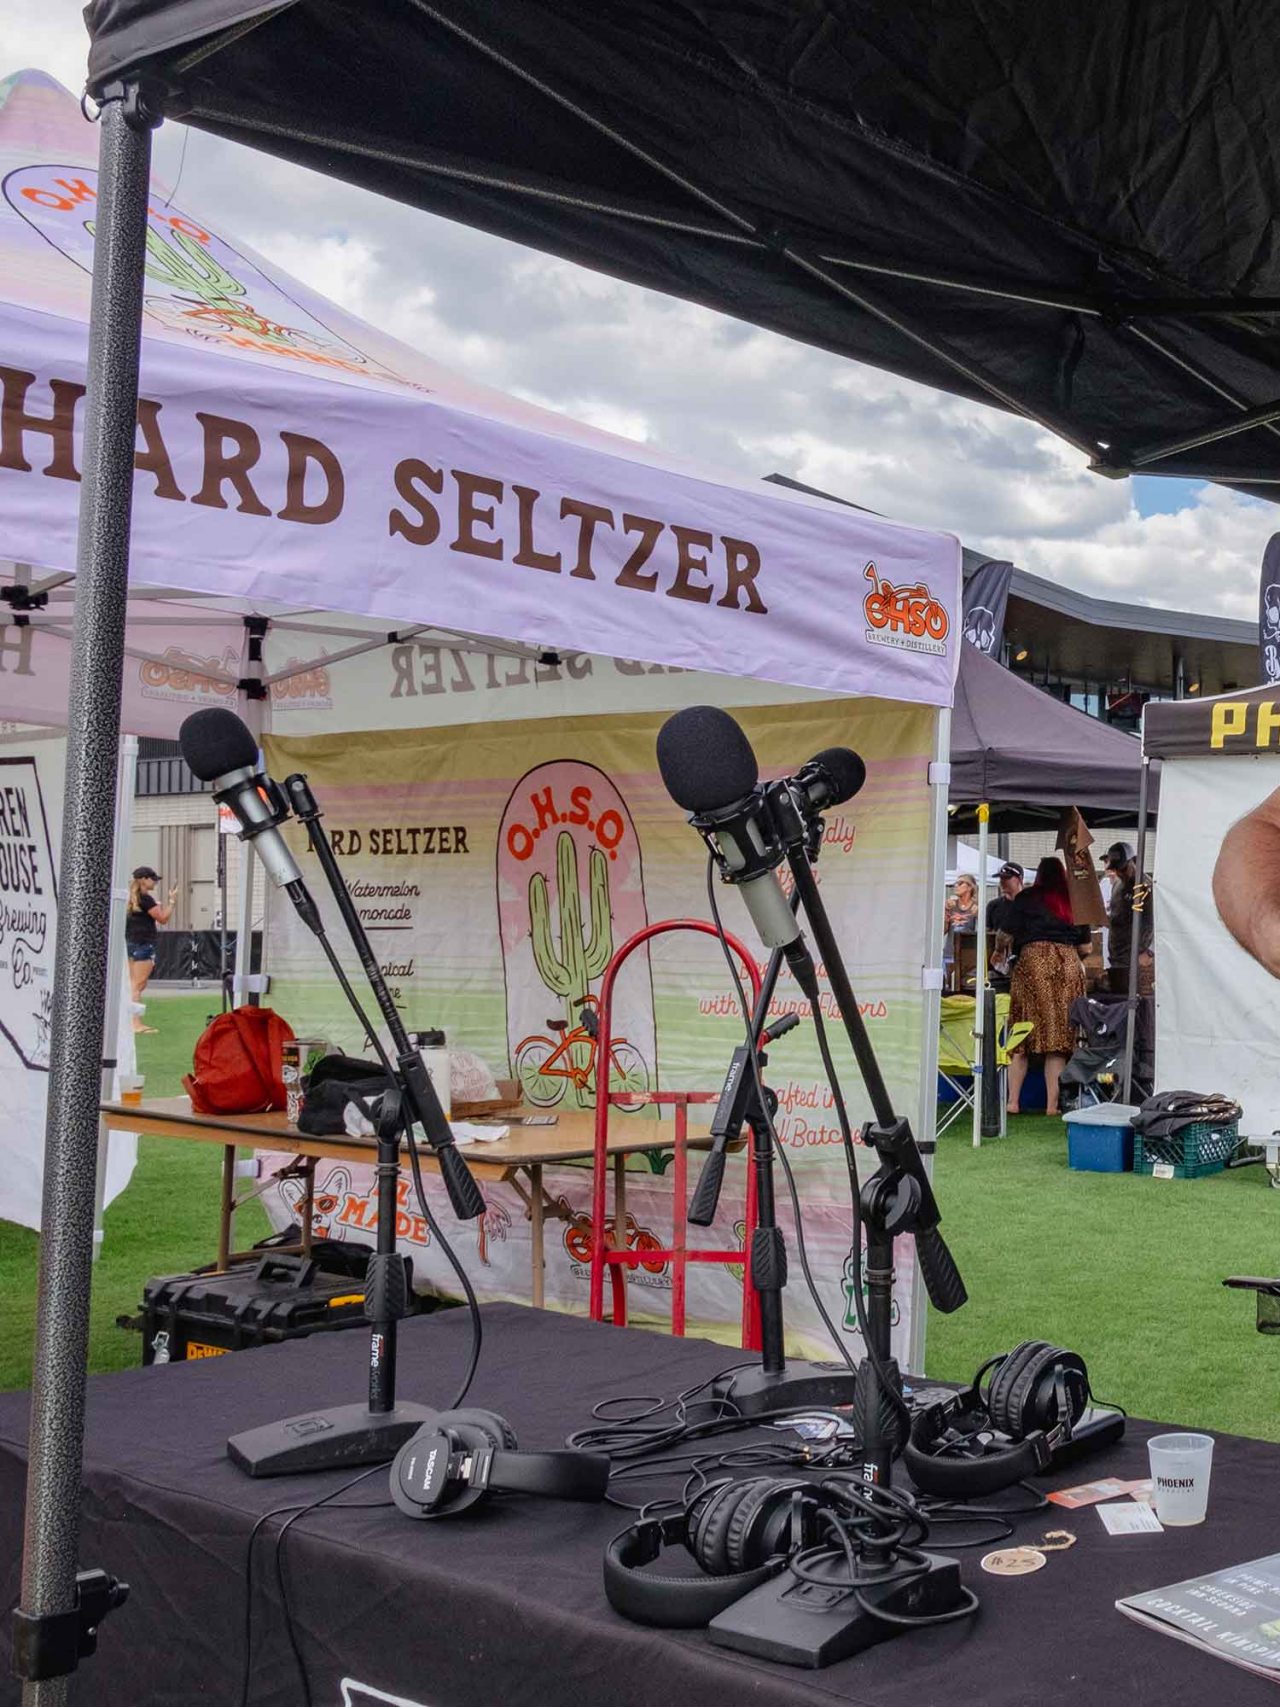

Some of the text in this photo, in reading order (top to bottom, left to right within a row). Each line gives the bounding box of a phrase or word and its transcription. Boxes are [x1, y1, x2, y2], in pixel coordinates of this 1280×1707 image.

[0, 365, 769, 616] HARD SELTZER
[866, 592, 948, 640] OHSO
[867, 632, 899, 645] BREWERY
[906, 640, 945, 655] DISTILLERY
[0, 787, 31, 838] REN
[369, 826, 470, 856] SELTZER
[0, 843, 43, 895] OUSE
[357, 903, 412, 921] monade
[700, 992, 735, 1016] with
[776, 1082, 819, 1114] afted
[423, 1448, 438, 1490] TASCAM
[1157, 1477, 1194, 1487] PHOENIX
[1147, 1598, 1219, 1632] COCKTAIL
